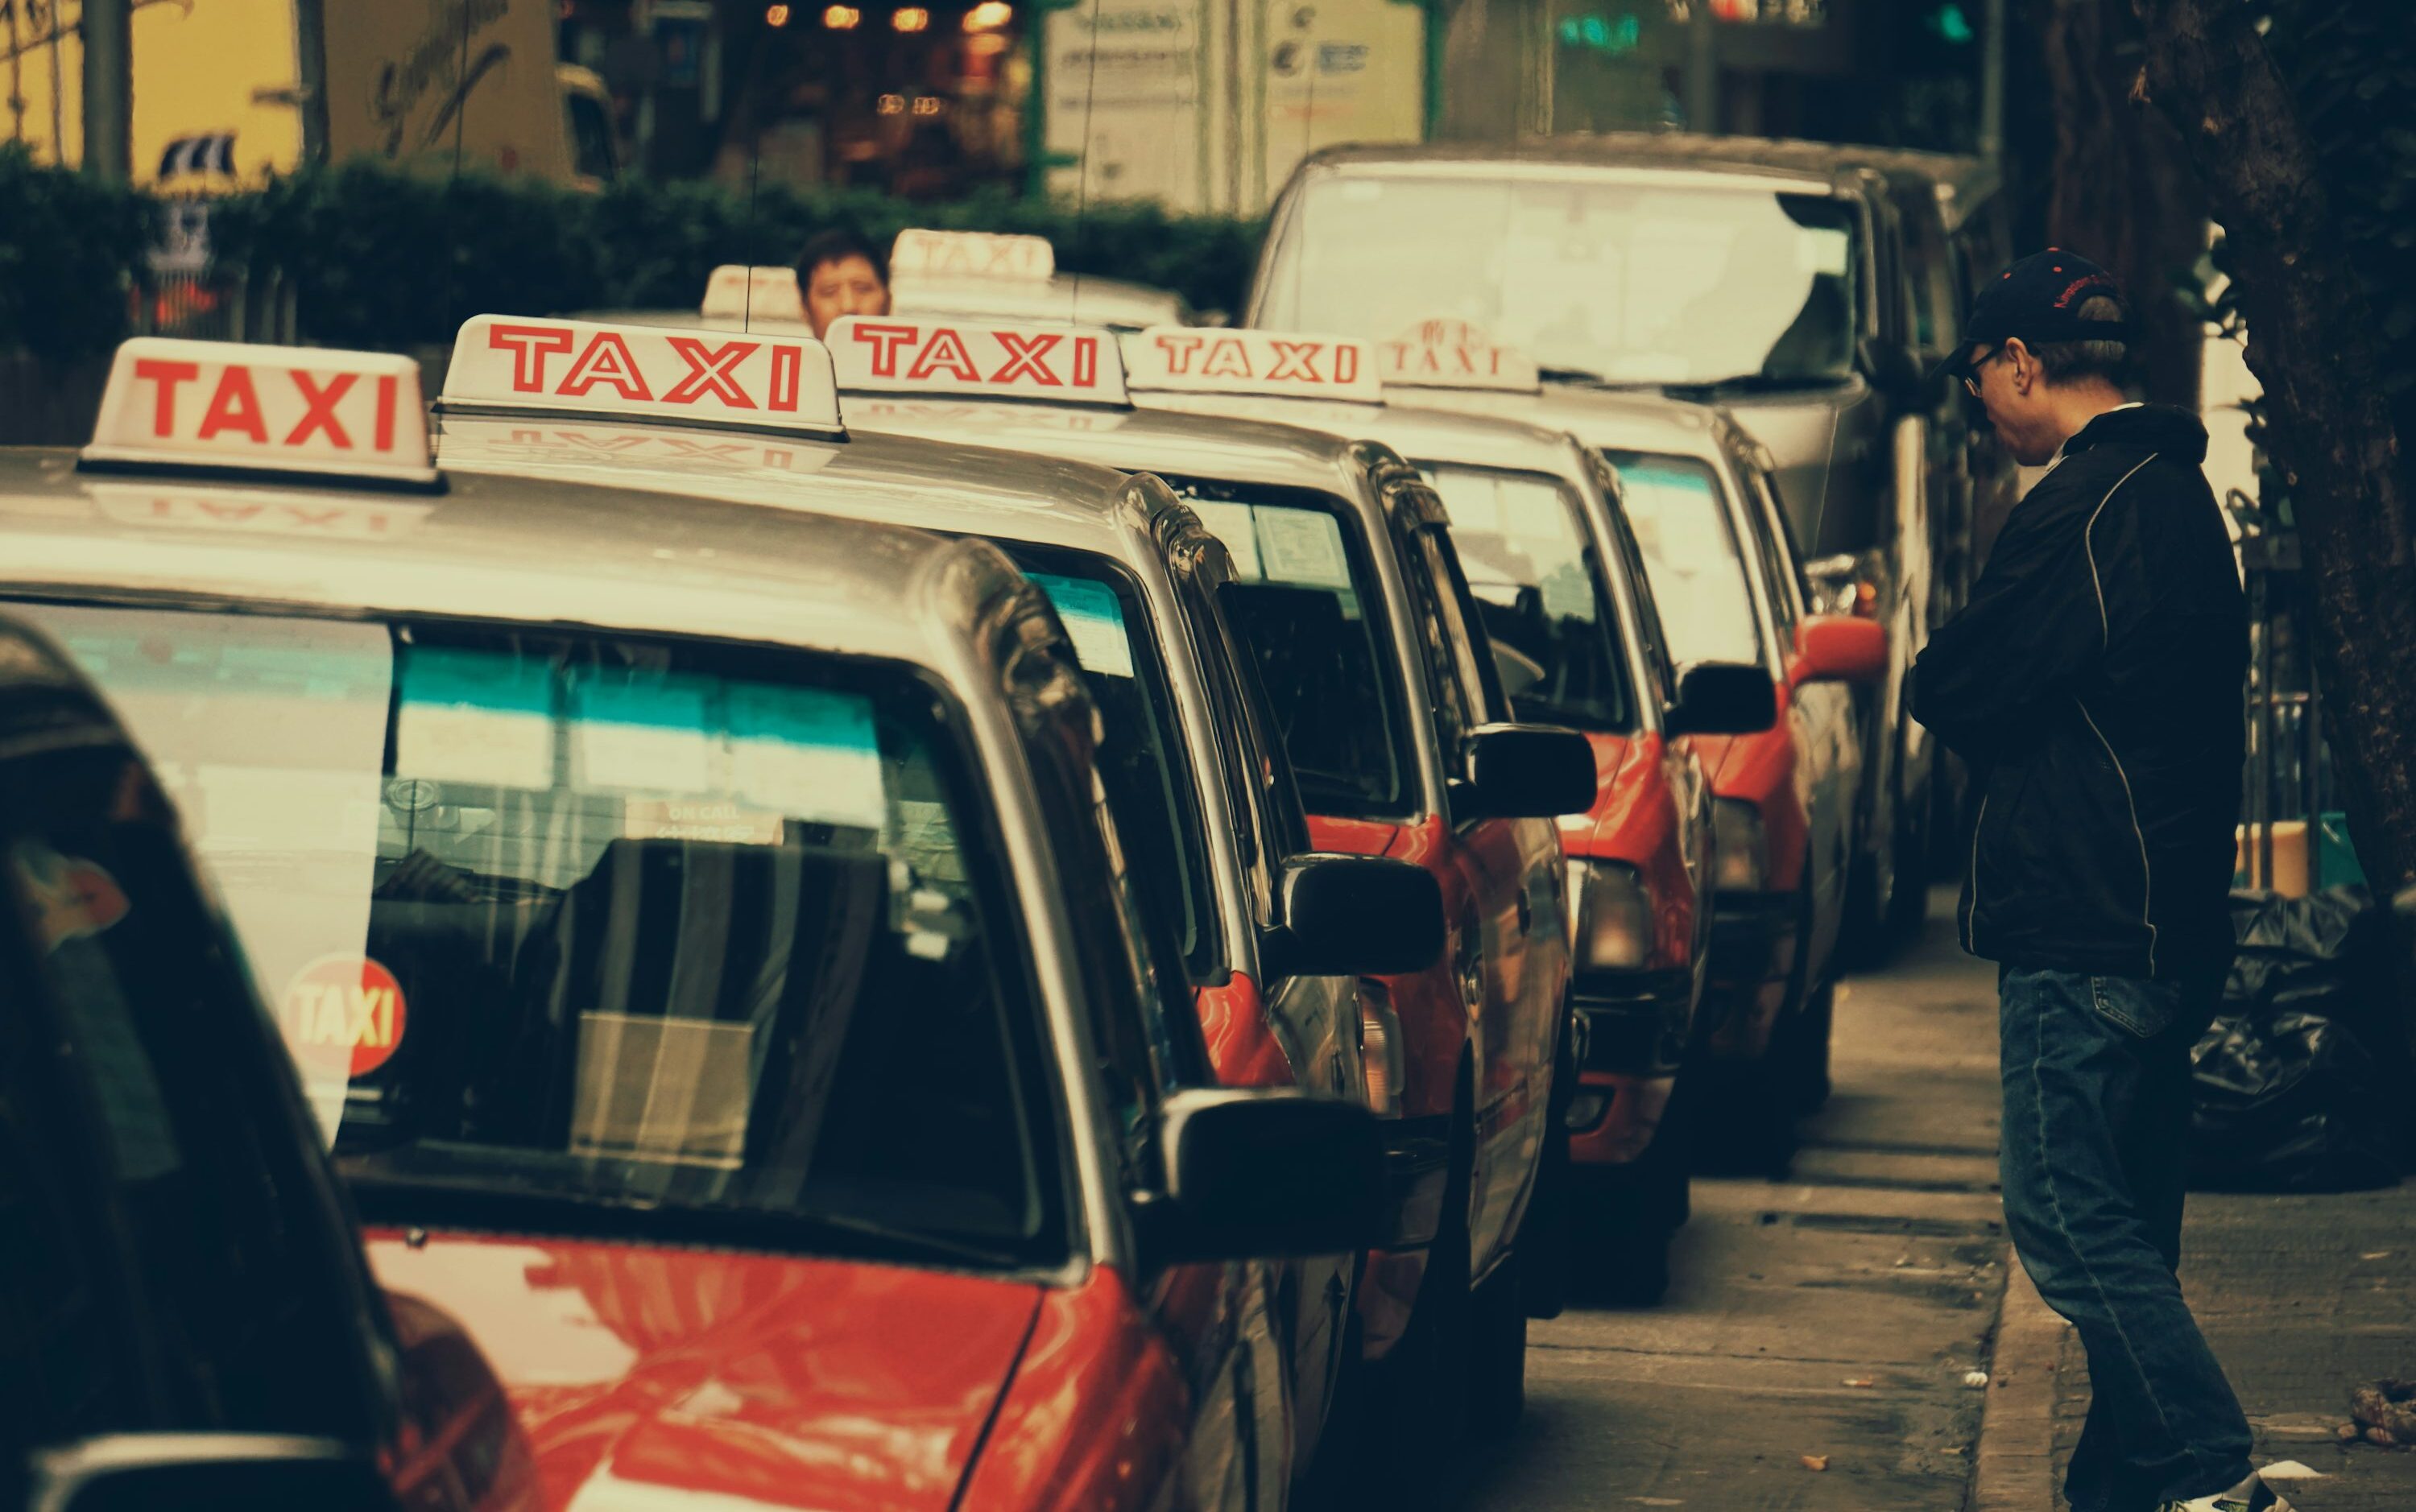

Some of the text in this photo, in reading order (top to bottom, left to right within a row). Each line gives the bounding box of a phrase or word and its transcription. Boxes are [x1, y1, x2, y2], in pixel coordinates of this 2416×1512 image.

[490, 324, 802, 411] TAXI
[854, 324, 1097, 387] TAXI
[1156, 336, 1359, 383] TAXI
[1385, 342, 1500, 375] TAXI
[135, 359, 397, 451] TAXI
[669, 805, 740, 820] ON CALL
[295, 984, 395, 1047] TAXI
